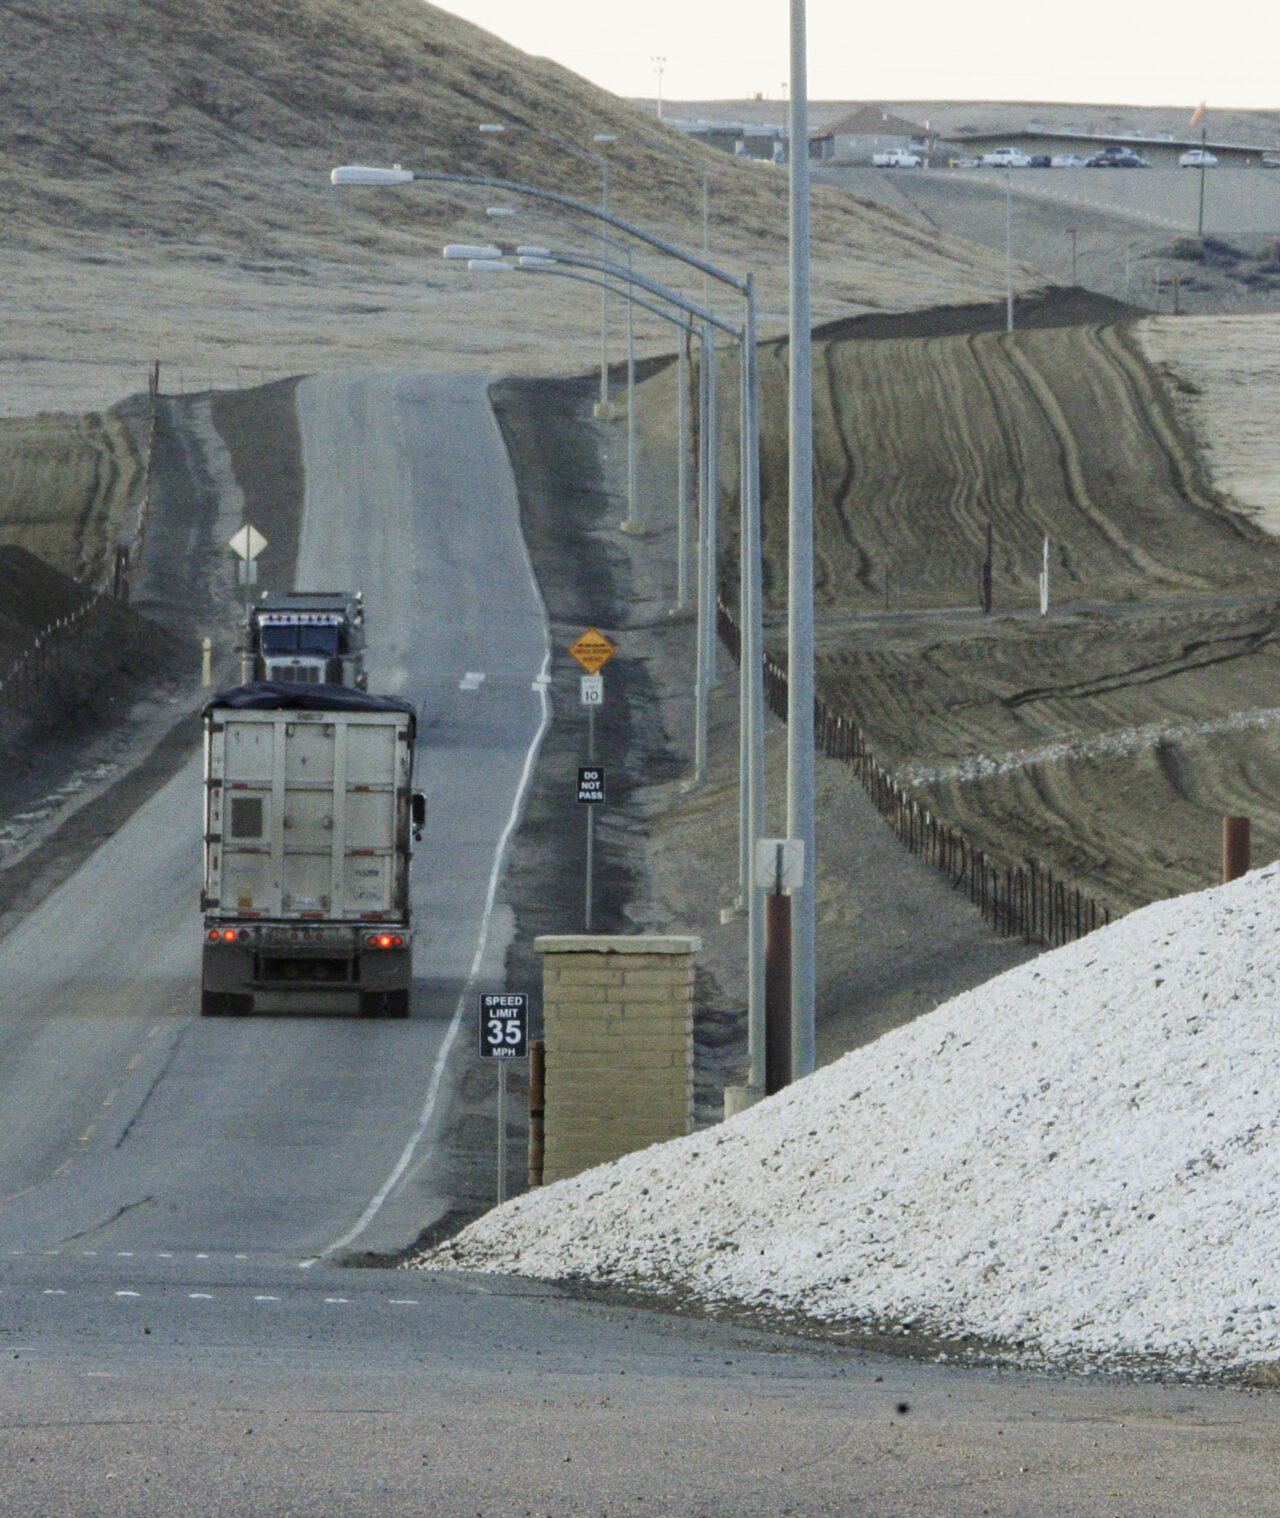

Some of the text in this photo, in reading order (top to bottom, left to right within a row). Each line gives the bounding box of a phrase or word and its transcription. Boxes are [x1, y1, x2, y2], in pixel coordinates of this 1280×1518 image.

[585, 690, 599, 702] 10
[584, 771, 598, 780] DO
[581, 781, 600, 790] NOT
[579, 791, 603, 800] PASS
[485, 996, 523, 1006] SPEED
[489, 1008, 518, 1018] LIMIT
[486, 1019, 522, 1045] 35
[492, 1047, 516, 1057] MPH
